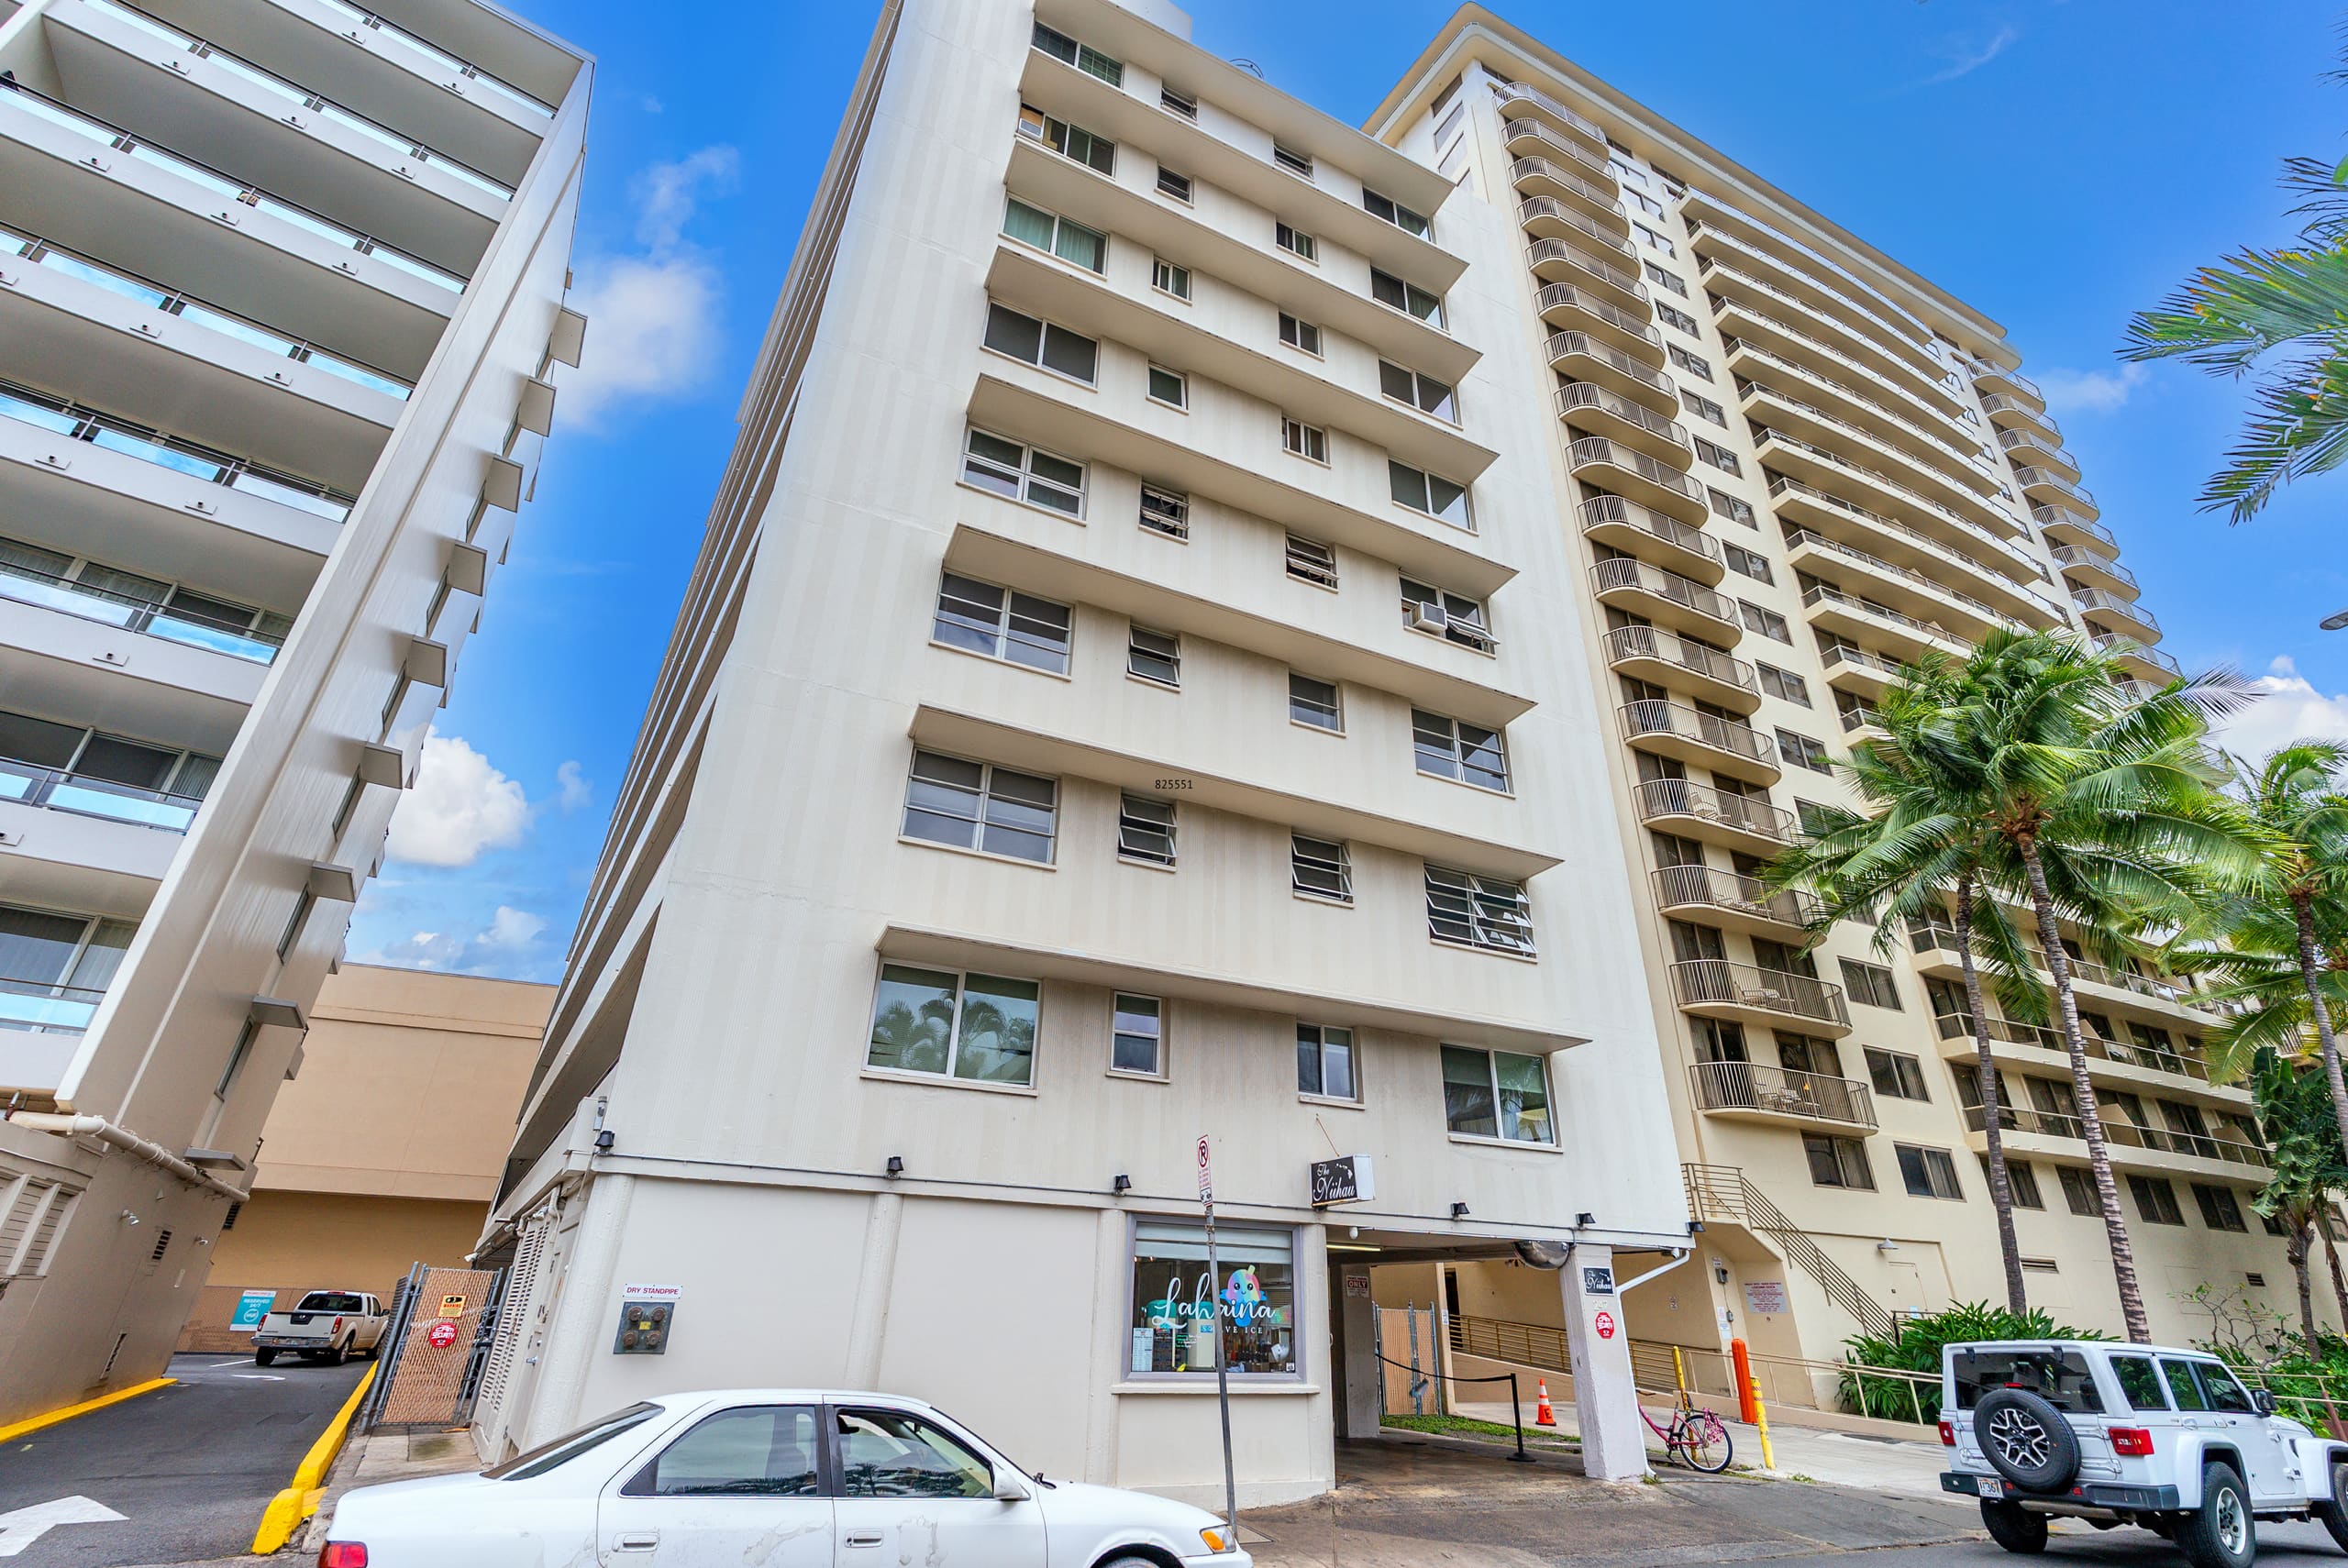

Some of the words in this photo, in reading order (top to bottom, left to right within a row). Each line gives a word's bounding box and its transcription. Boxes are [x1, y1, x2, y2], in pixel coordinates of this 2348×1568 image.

[1316, 1163, 1330, 1176] The
[1312, 1176, 1356, 1201] Niihau
[1348, 1280, 1367, 1288] ONLY
[1152, 1272, 1276, 1329] Lahaina
[1245, 1326, 1263, 1334] ICE
